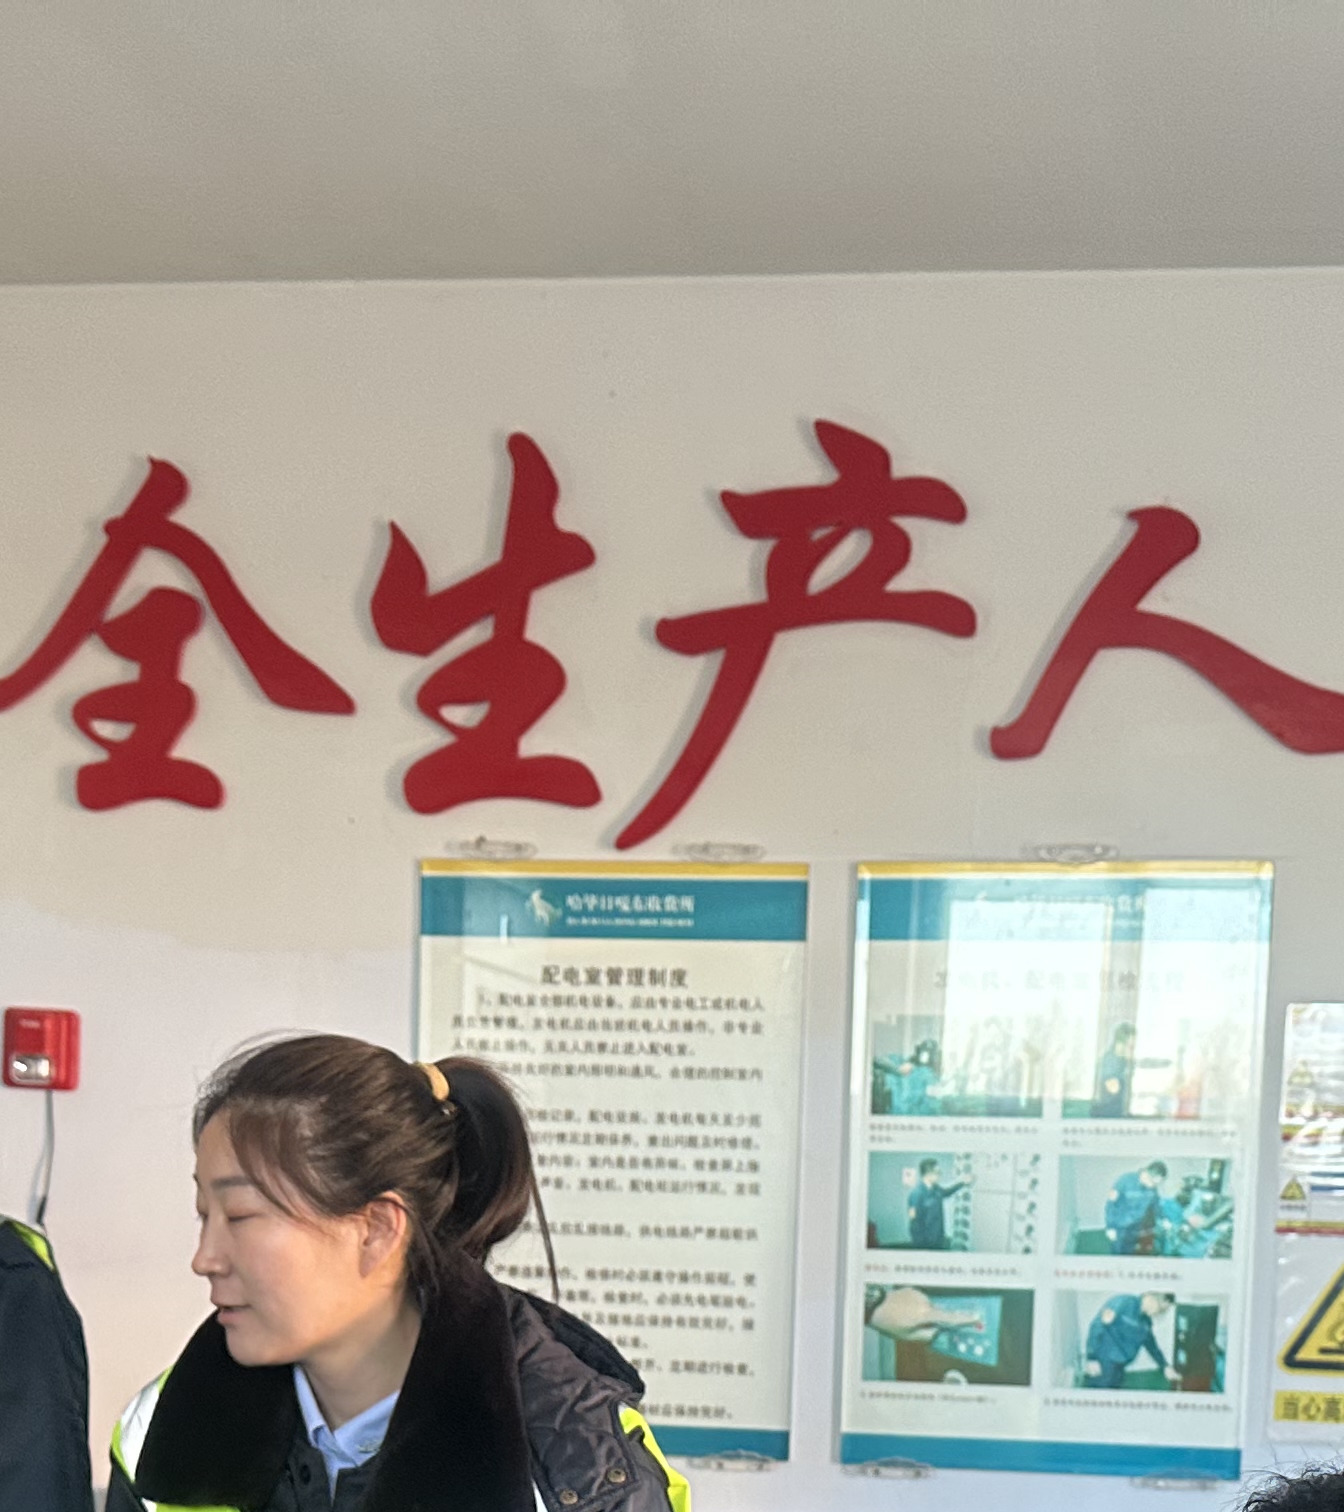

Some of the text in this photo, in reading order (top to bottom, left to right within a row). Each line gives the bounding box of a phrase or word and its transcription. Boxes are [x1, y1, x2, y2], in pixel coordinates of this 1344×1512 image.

[540, 964, 689, 989] 配电室管理制度
